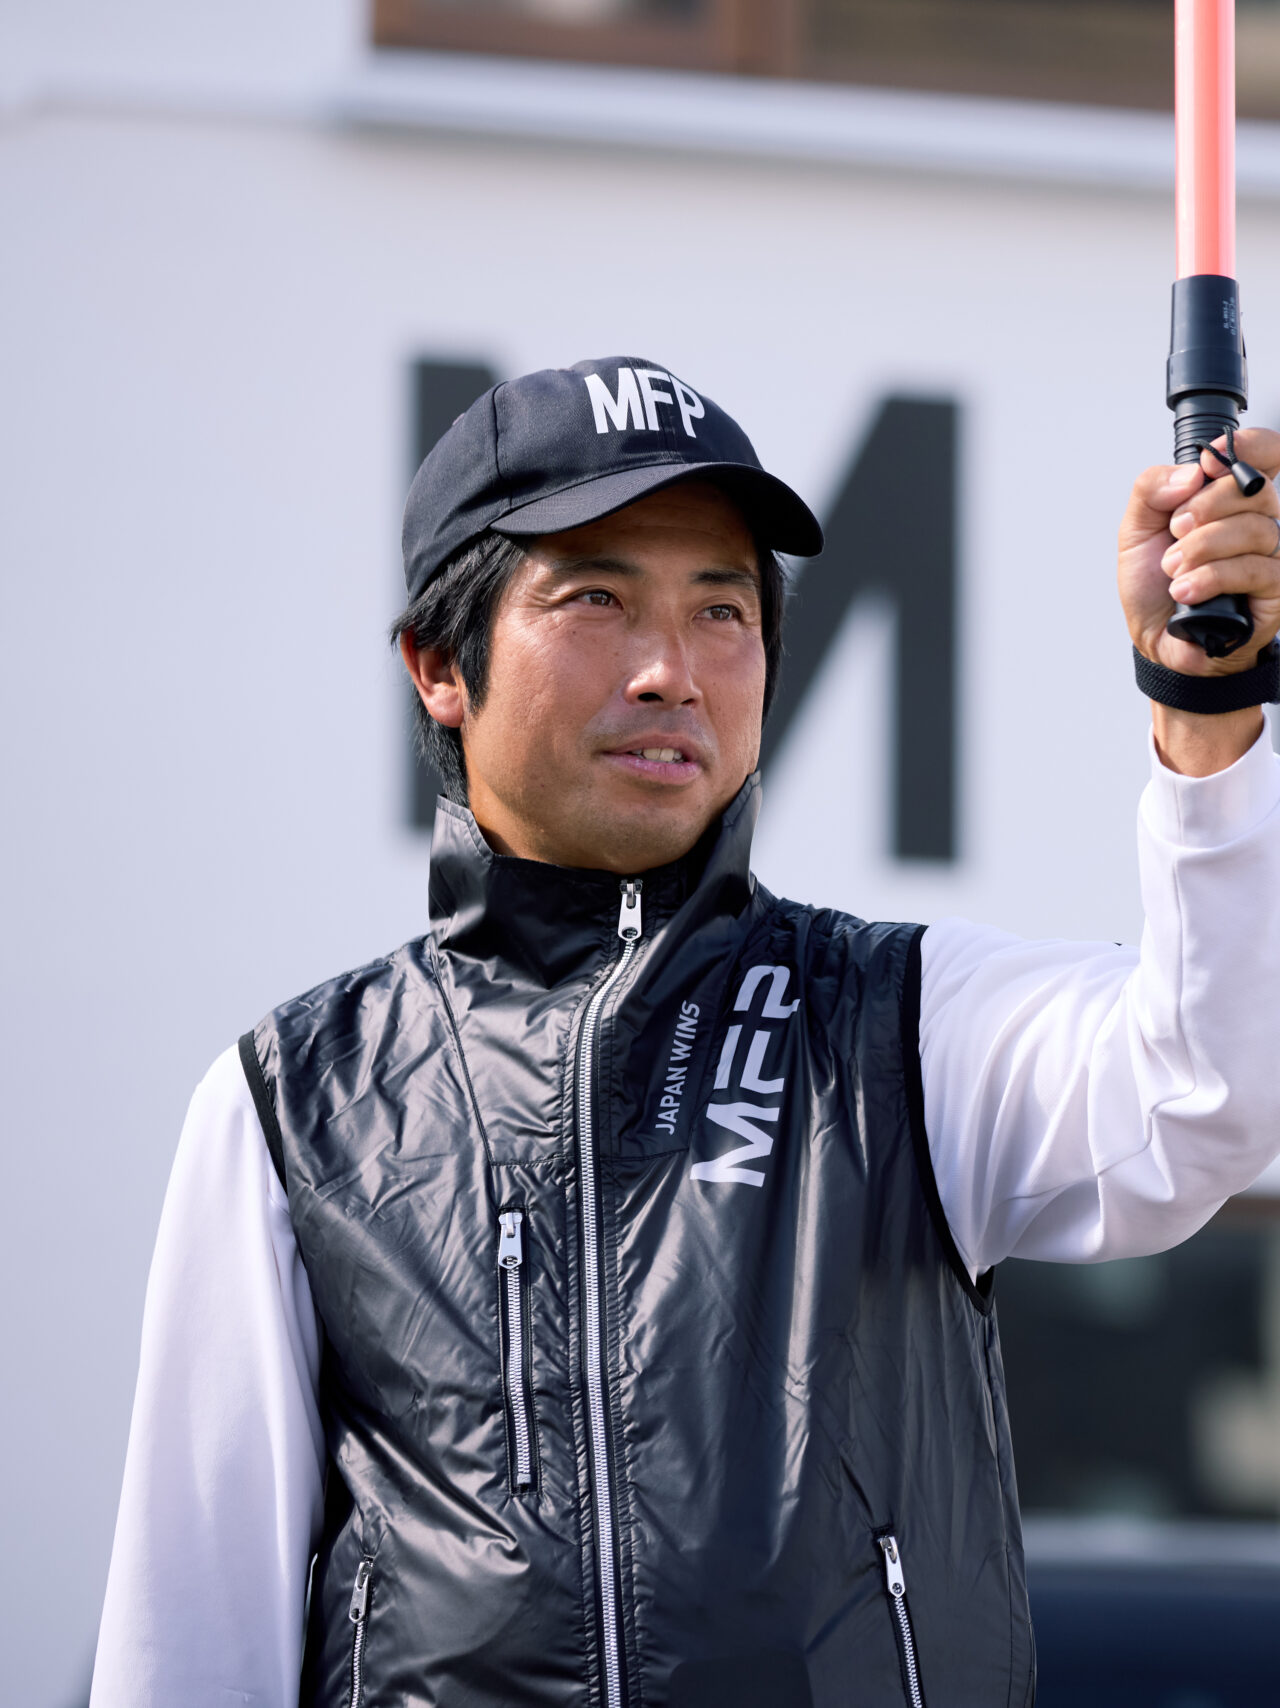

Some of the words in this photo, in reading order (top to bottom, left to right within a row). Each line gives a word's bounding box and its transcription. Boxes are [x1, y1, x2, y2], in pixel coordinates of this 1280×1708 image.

[584, 367, 705, 439] MFP
[670, 1000, 701, 1062] WINS
[655, 1066, 688, 1135] JAPAN
[690, 965, 801, 1187] MFP
